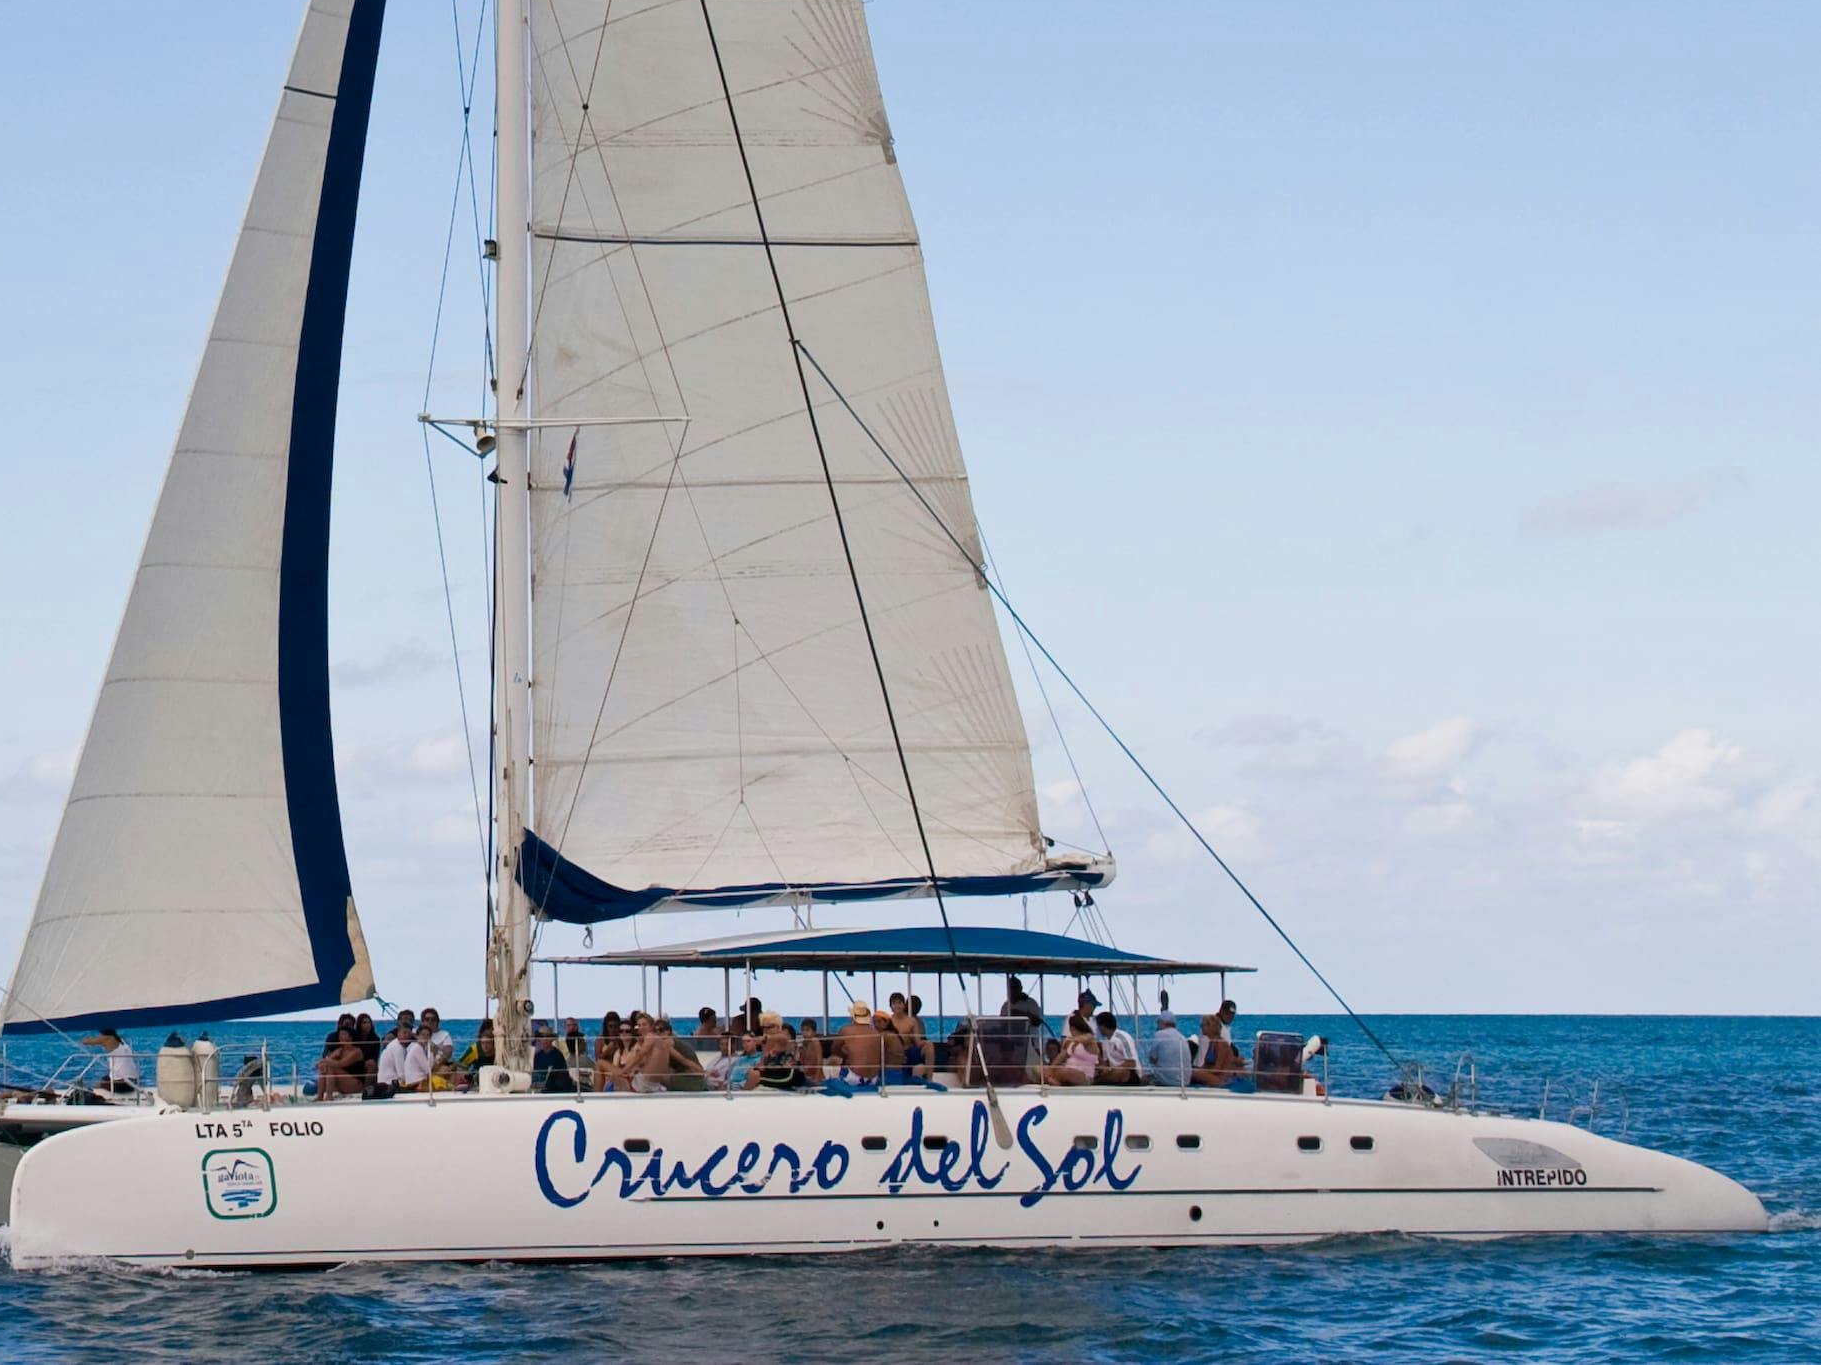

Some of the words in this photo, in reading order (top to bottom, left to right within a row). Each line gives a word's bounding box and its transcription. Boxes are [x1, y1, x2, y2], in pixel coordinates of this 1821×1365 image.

[195, 1123, 228, 1138] LTA
[269, 1121, 324, 1136] FOLIO
[535, 1109, 849, 1207] Crucero
[878, 1100, 1010, 1193] del
[1017, 1104, 1142, 1207] Sol
[1497, 1169, 1587, 1186] INTREPIDO
